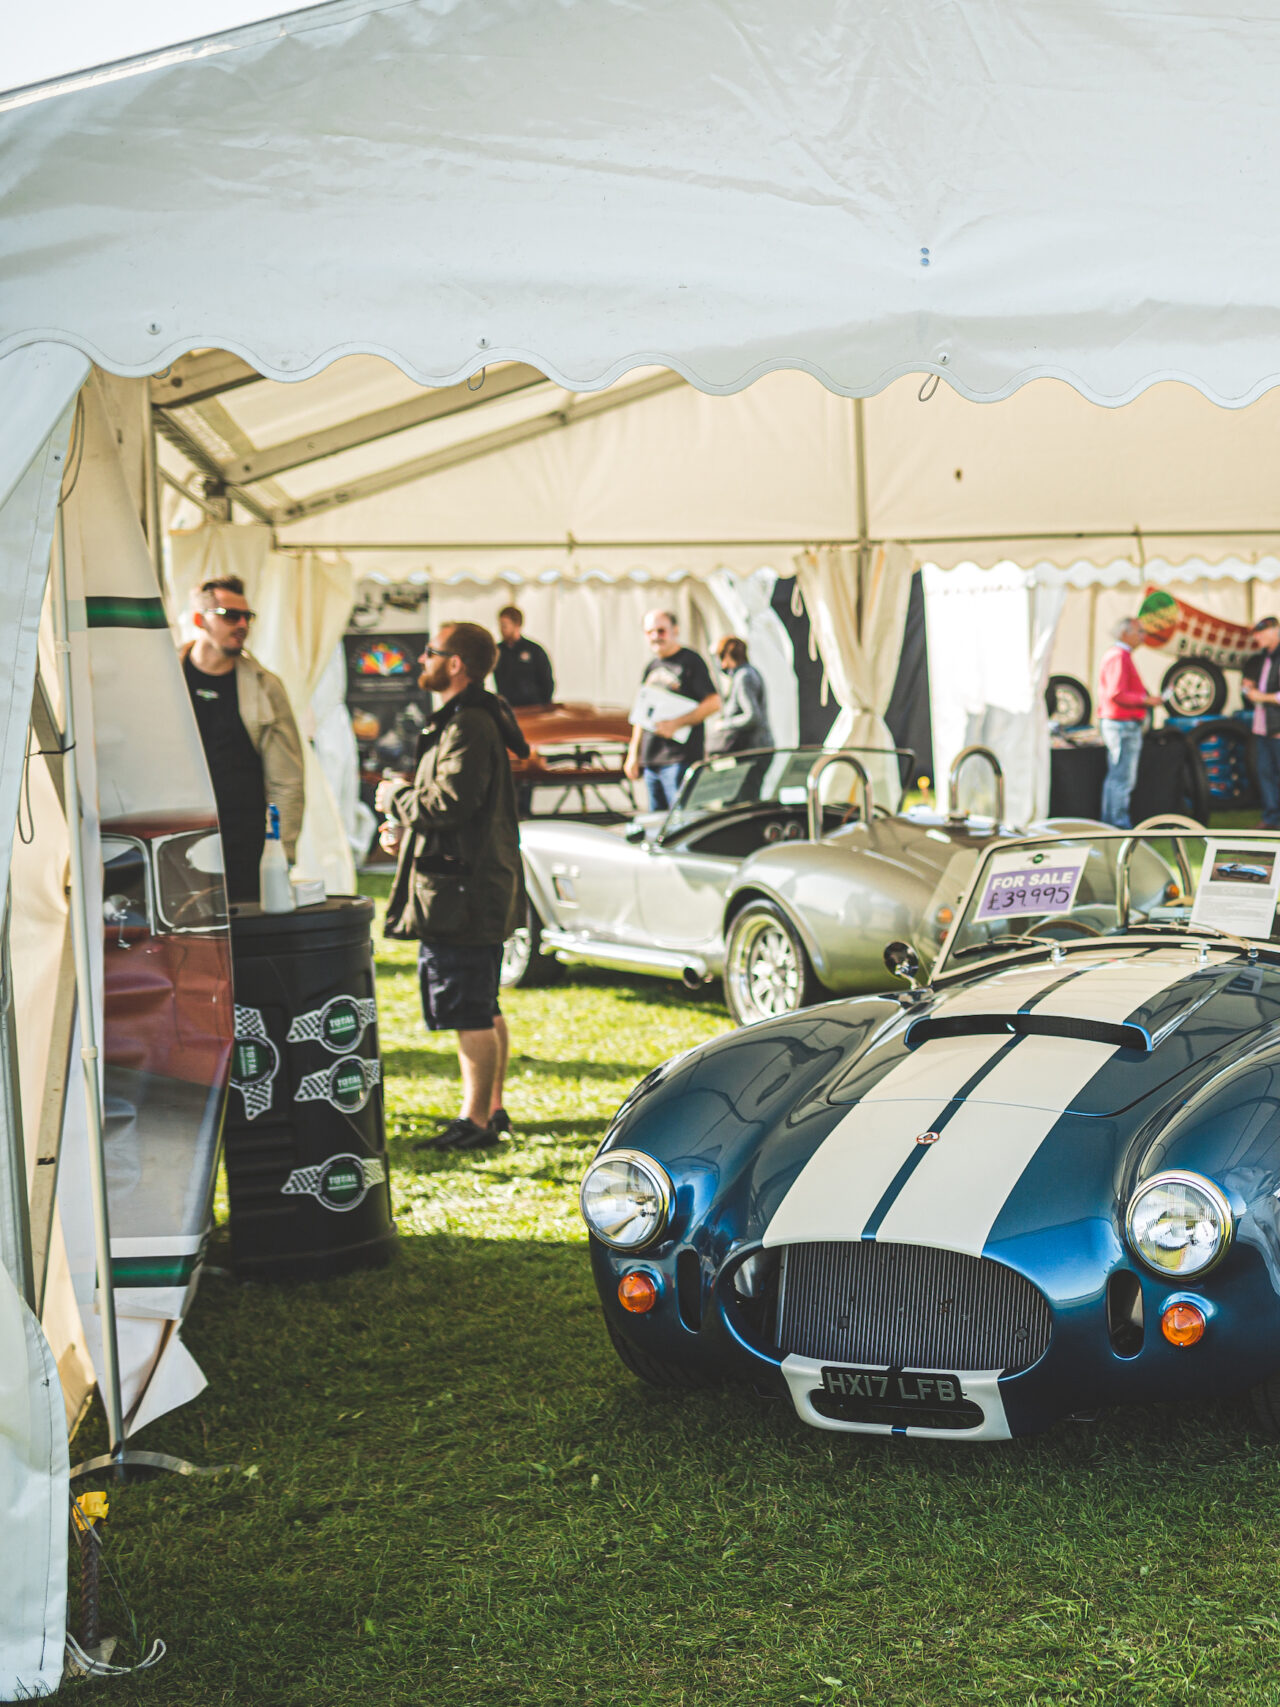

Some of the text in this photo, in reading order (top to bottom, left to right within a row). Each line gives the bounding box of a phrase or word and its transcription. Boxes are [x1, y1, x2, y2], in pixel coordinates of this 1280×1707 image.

[991, 871, 1074, 890] FOR SALE
[329, 1014, 355, 1028] TOTAL
[248, 1045, 257, 1074] TOTAL
[337, 1074, 361, 1087] TOTAL
[328, 1174, 357, 1185] TOTAL
[826, 1372, 957, 1401] HX17 LFB
